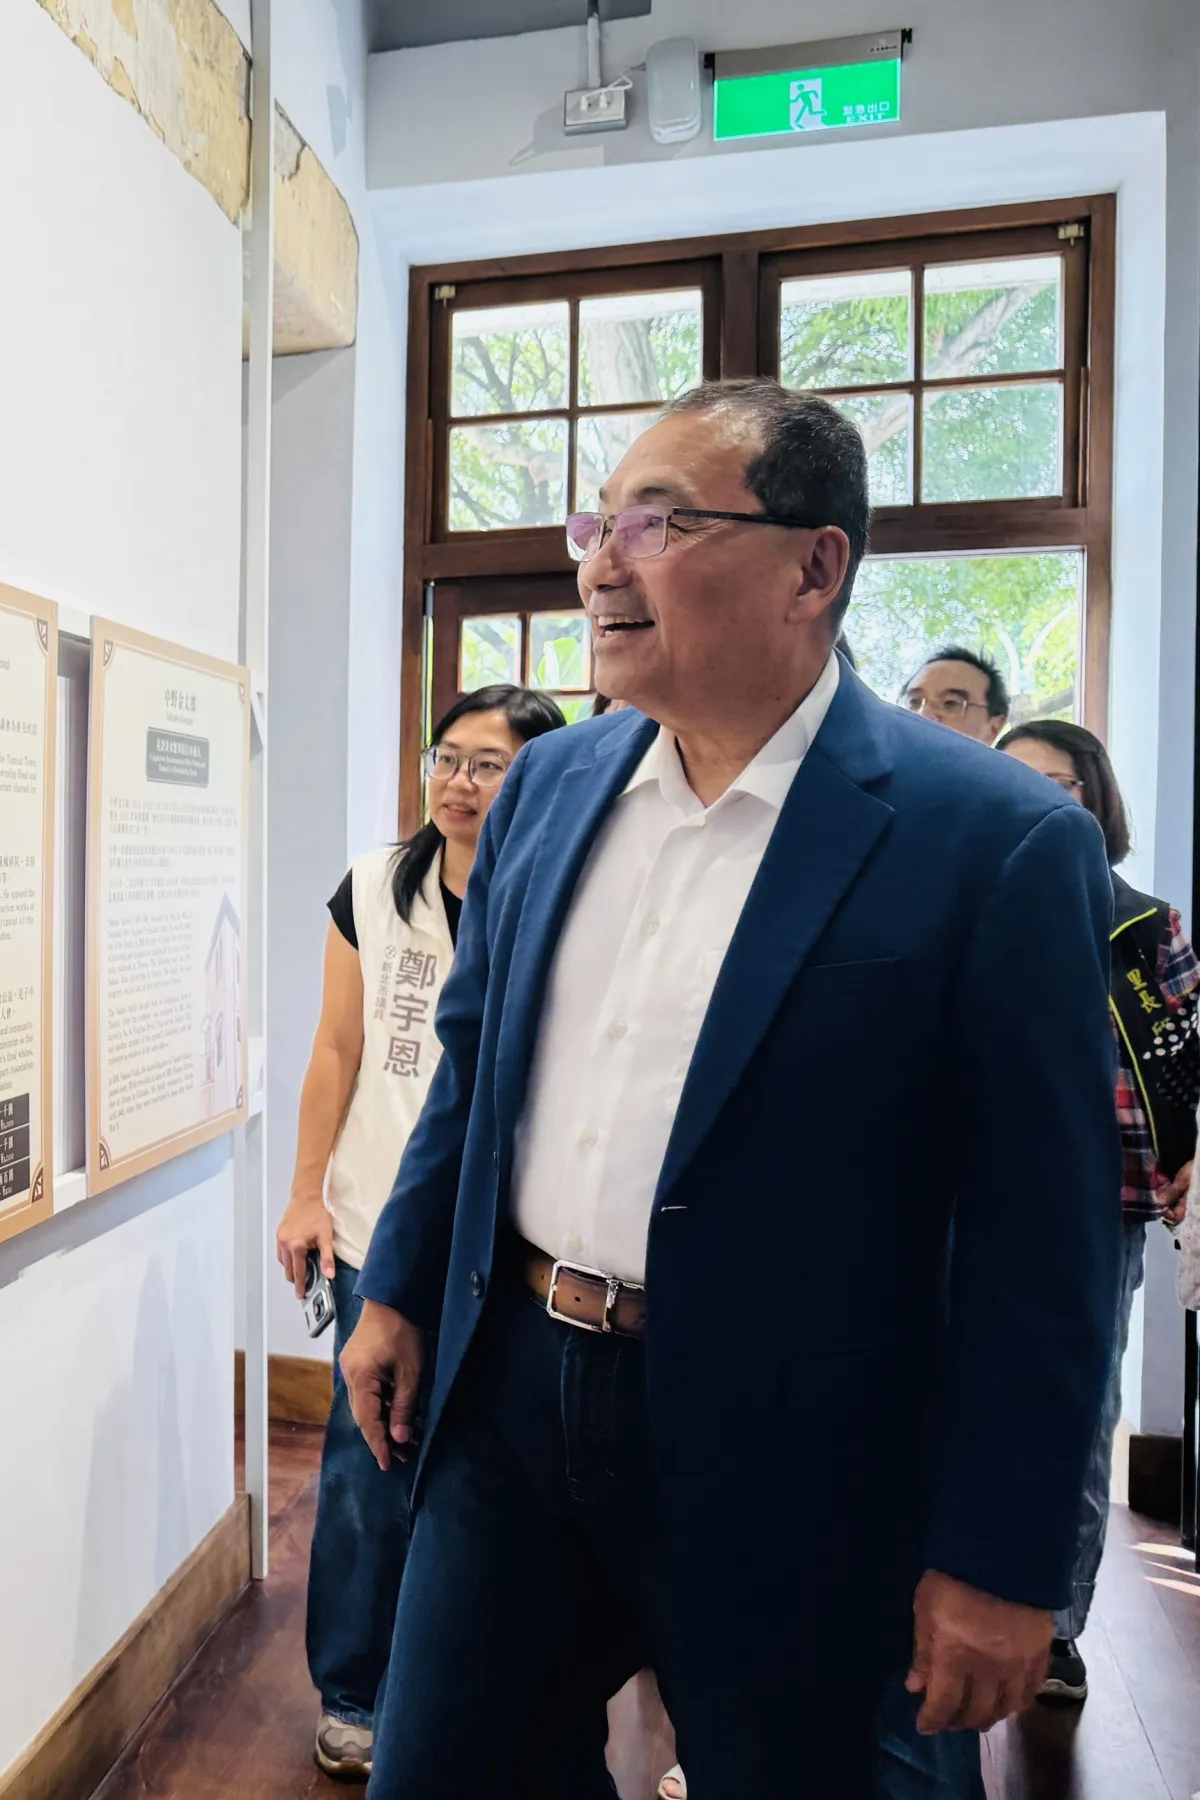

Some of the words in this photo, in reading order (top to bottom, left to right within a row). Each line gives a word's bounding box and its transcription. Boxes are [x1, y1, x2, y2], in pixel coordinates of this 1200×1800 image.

[846, 112, 887, 125] EXIT
[383, 947, 437, 1078] 鄭宇恩
